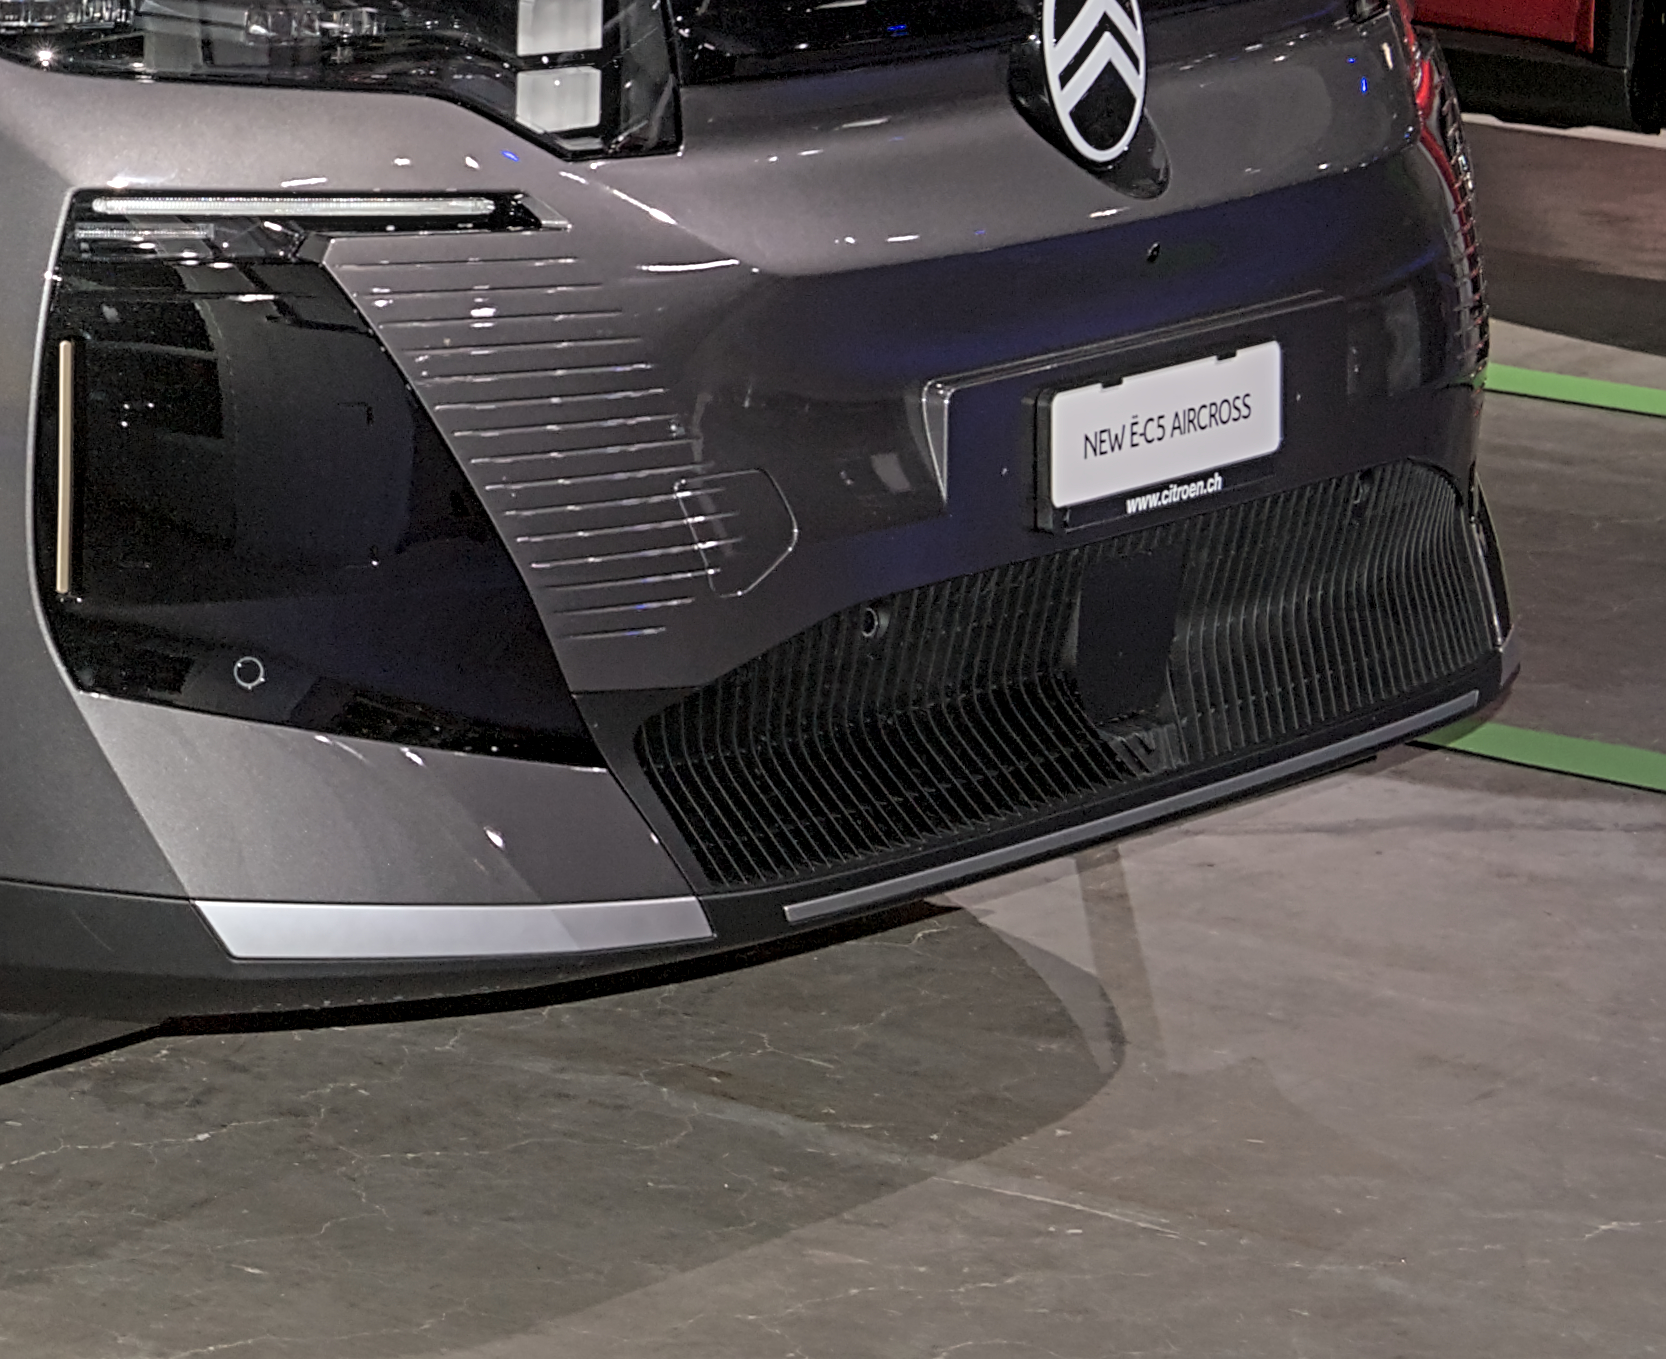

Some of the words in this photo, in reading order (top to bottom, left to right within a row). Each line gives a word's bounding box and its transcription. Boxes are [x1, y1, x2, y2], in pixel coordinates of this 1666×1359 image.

[1084, 424, 1126, 460] NEW
[1130, 415, 1166, 448] Ë-C5
[1170, 393, 1252, 439] AIRCROSS
[1126, 472, 1224, 514] www.citroen.ch
